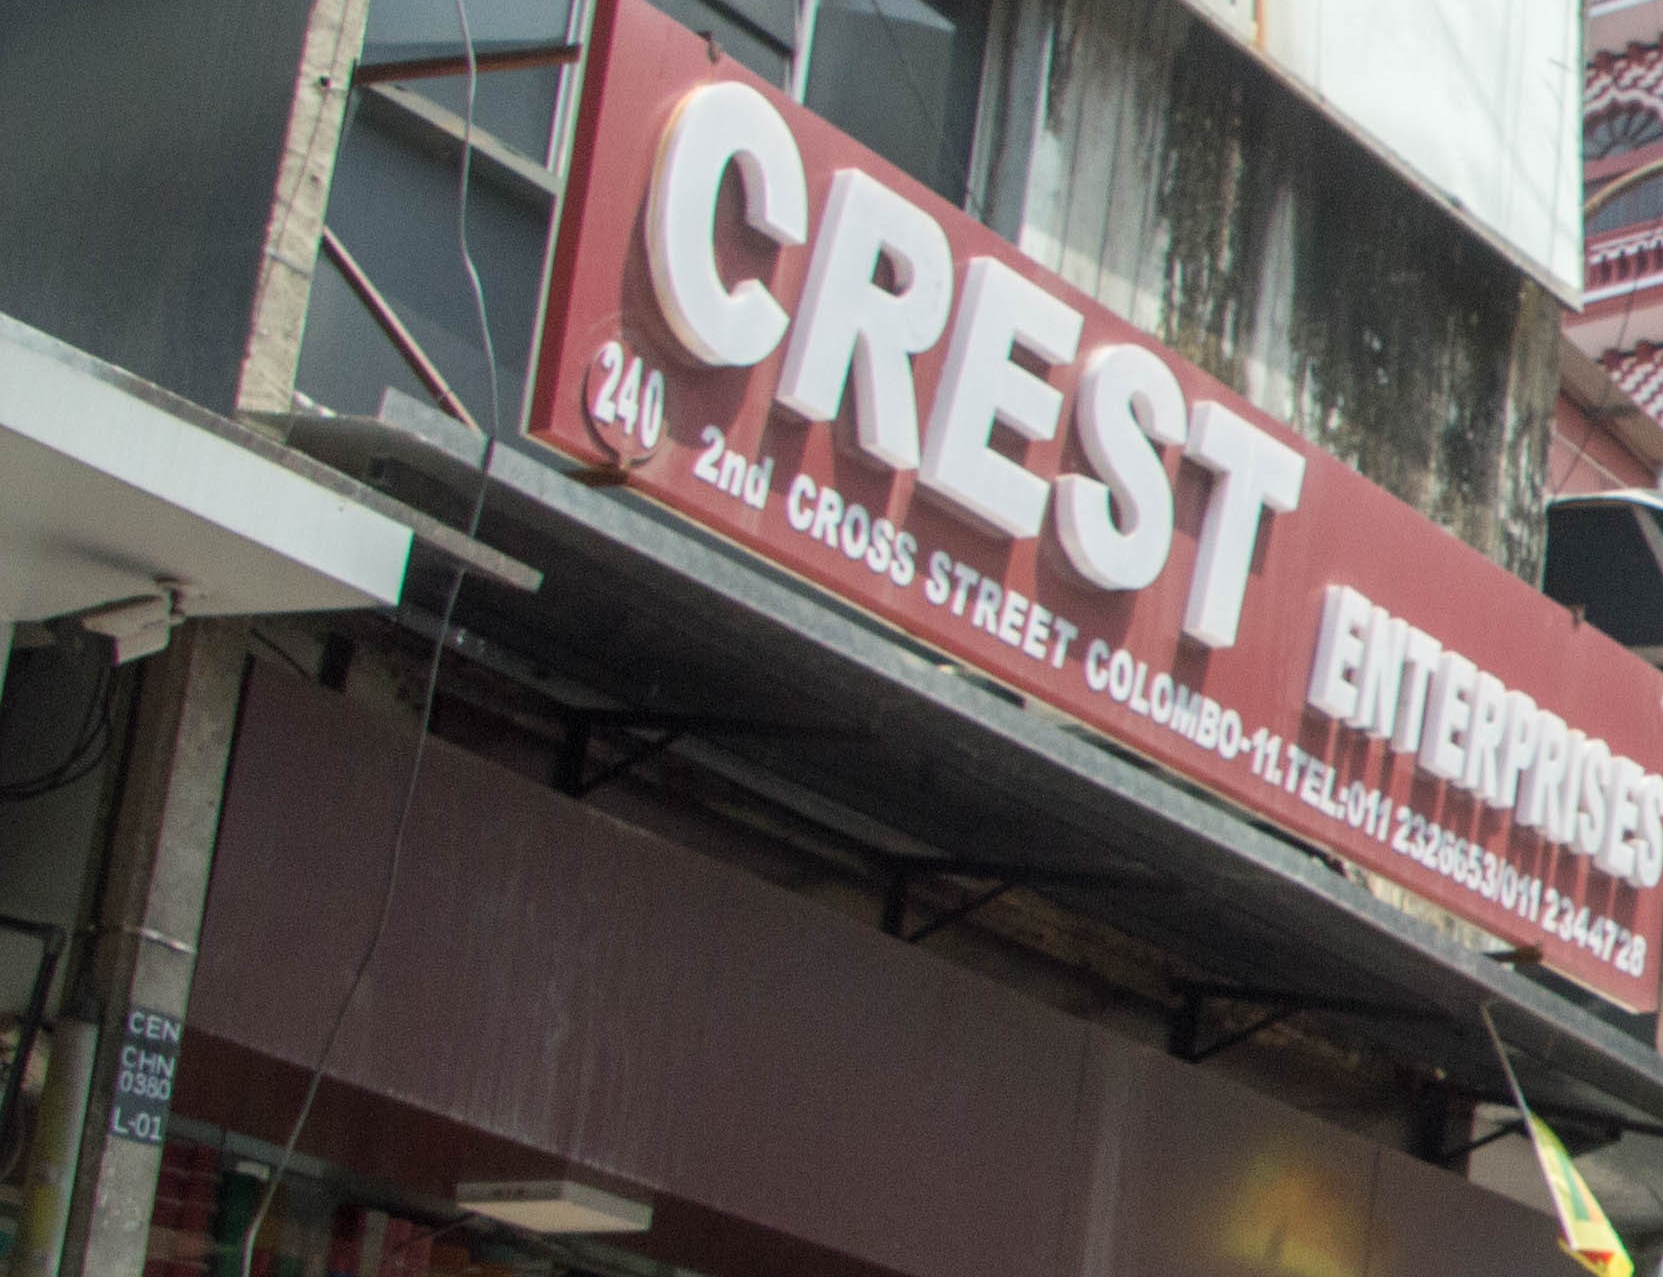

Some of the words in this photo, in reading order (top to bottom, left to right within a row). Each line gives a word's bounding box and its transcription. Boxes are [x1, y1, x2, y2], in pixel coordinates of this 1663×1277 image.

[646, 81, 1305, 650] CREST
[591, 340, 666, 451] 240
[692, 424, 776, 511] 2nd
[786, 472, 919, 588] CROSS
[923, 550, 1080, 670] STREET
[1540, 887, 1649, 979] 2344728
[127, 1010, 184, 1044] CEN
[120, 1045, 176, 1078] CHN
[119, 1070, 173, 1100] 0380
[110, 1106, 163, 1141] L-01
